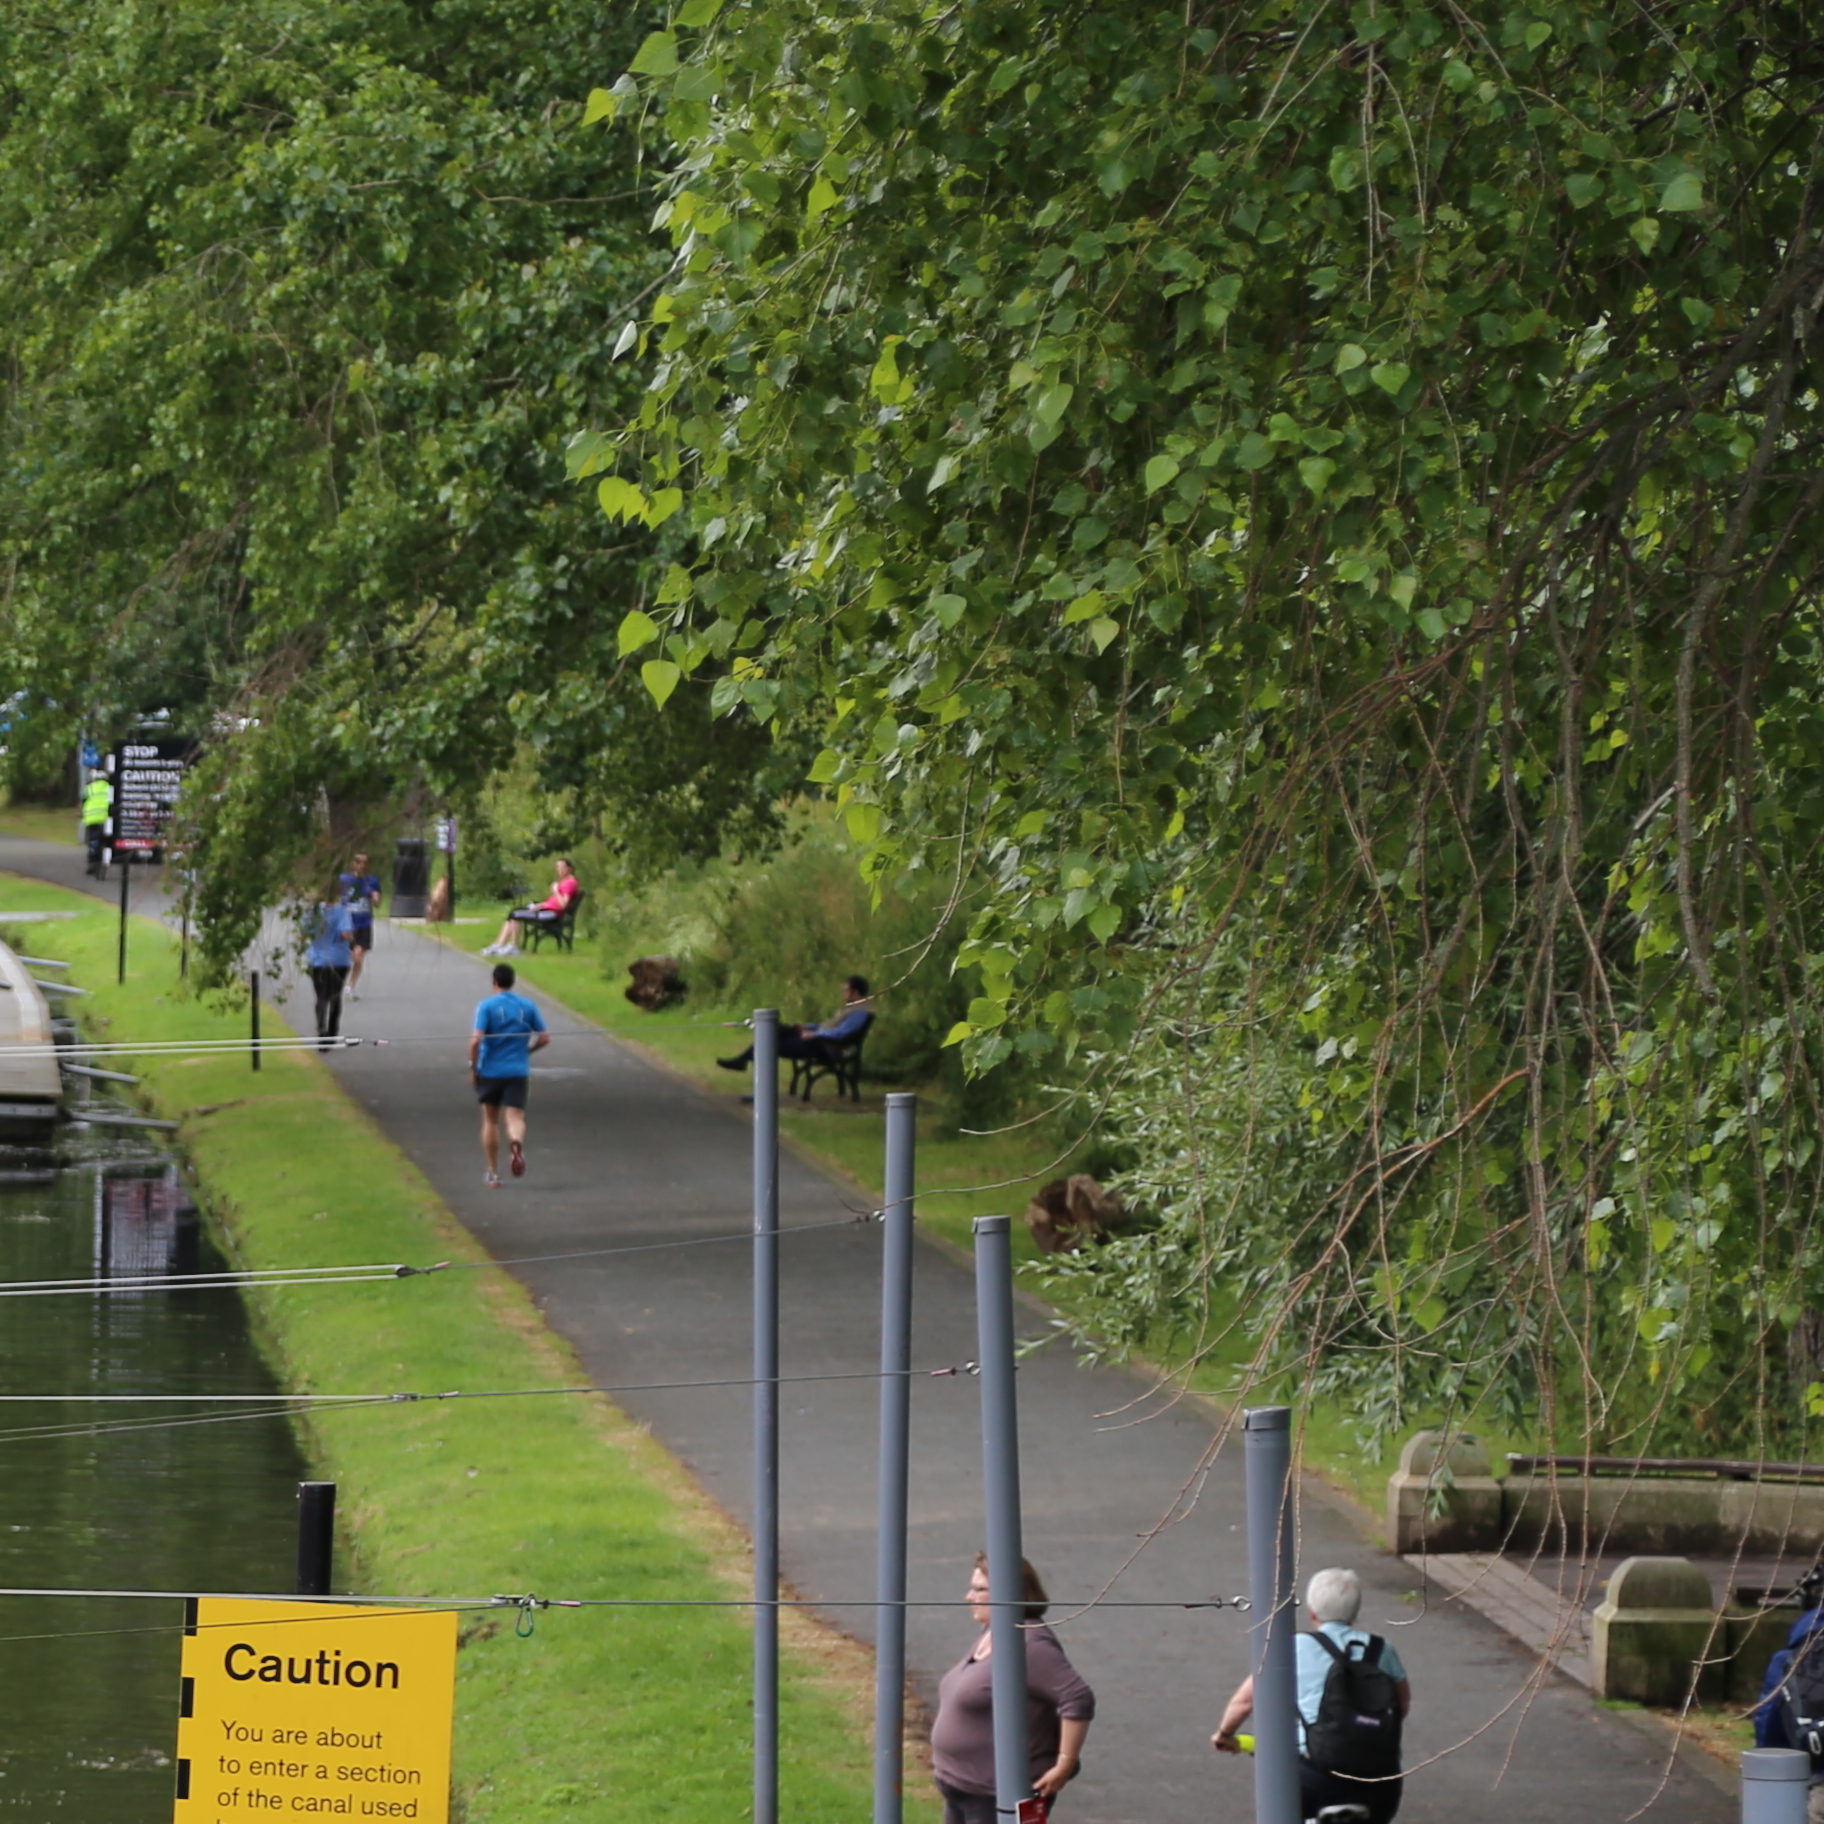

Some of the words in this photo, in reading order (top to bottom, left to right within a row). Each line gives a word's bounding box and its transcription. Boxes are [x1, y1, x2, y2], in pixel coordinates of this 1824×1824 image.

[122, 745, 159, 758] STOP
[121, 770, 180, 783] CAUTION
[224, 1642, 400, 1689] Caution
[221, 1720, 263, 1742] You
[271, 1728, 308, 1745] are
[316, 1727, 383, 1749] about
[219, 1755, 240, 1774] to
[249, 1758, 308, 1779] enter
[315, 1763, 329, 1779] a
[336, 1763, 421, 1785] section
[217, 1787, 239, 1807] of
[247, 1789, 283, 1810] the
[291, 1794, 353, 1813] canal
[361, 1798, 418, 1818] used
